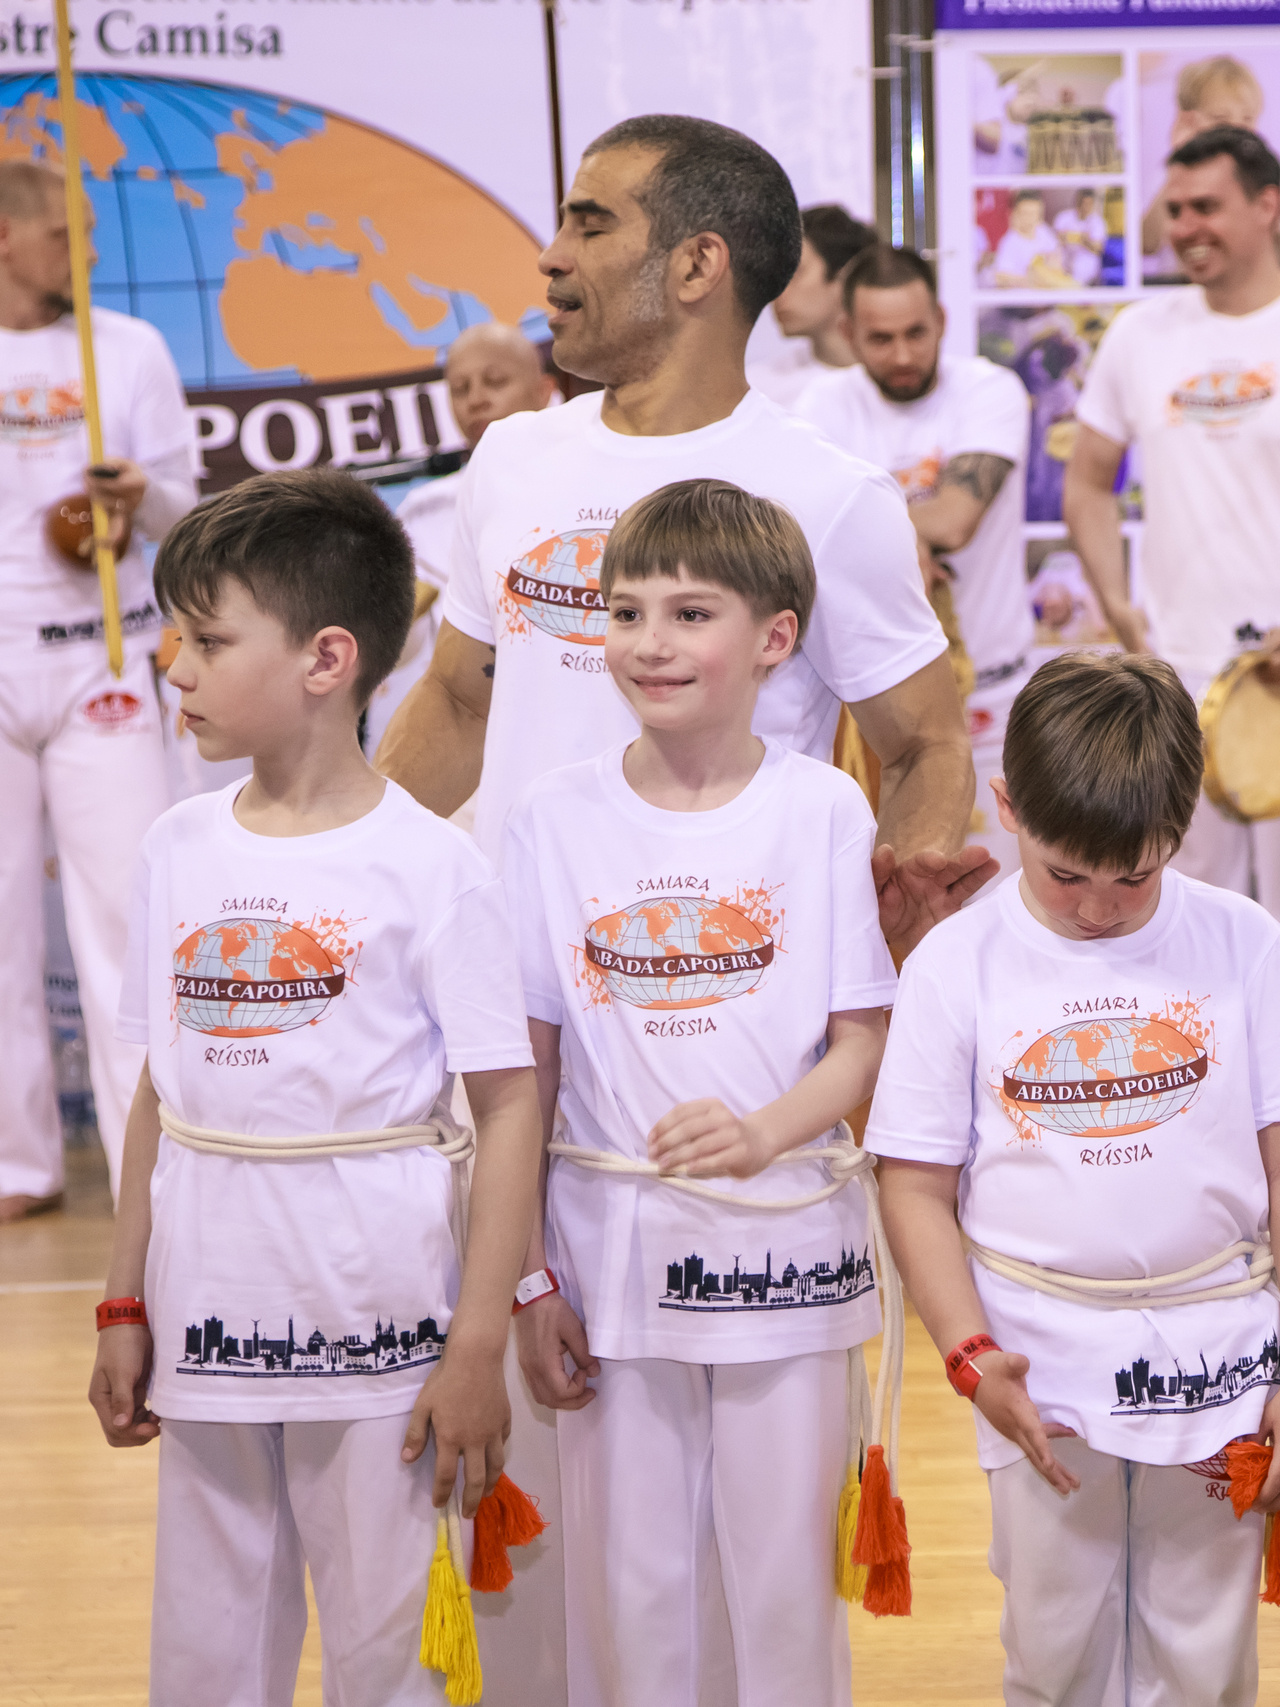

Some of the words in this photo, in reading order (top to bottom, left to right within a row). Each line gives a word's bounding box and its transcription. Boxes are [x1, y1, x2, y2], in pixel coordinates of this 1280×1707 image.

[95, 10, 283, 58] Camisa
[576, 506, 620, 523] SAMA
[635, 875, 711, 895] SAMARA
[219, 896, 289, 914] SAMARA
[593, 948, 764, 975] ABADÁ-CAPOEIRA
[175, 977, 331, 1000] BADÁ-CAPOEIRA
[1061, 996, 1139, 1017] SAMARA
[643, 1015, 717, 1037] RÚSSIA
[204, 1043, 270, 1067] RÚSSIA
[1015, 1066, 1198, 1101] ABADÁ-CAPOEIRA
[1079, 1142, 1153, 1167] RÚSSIA
